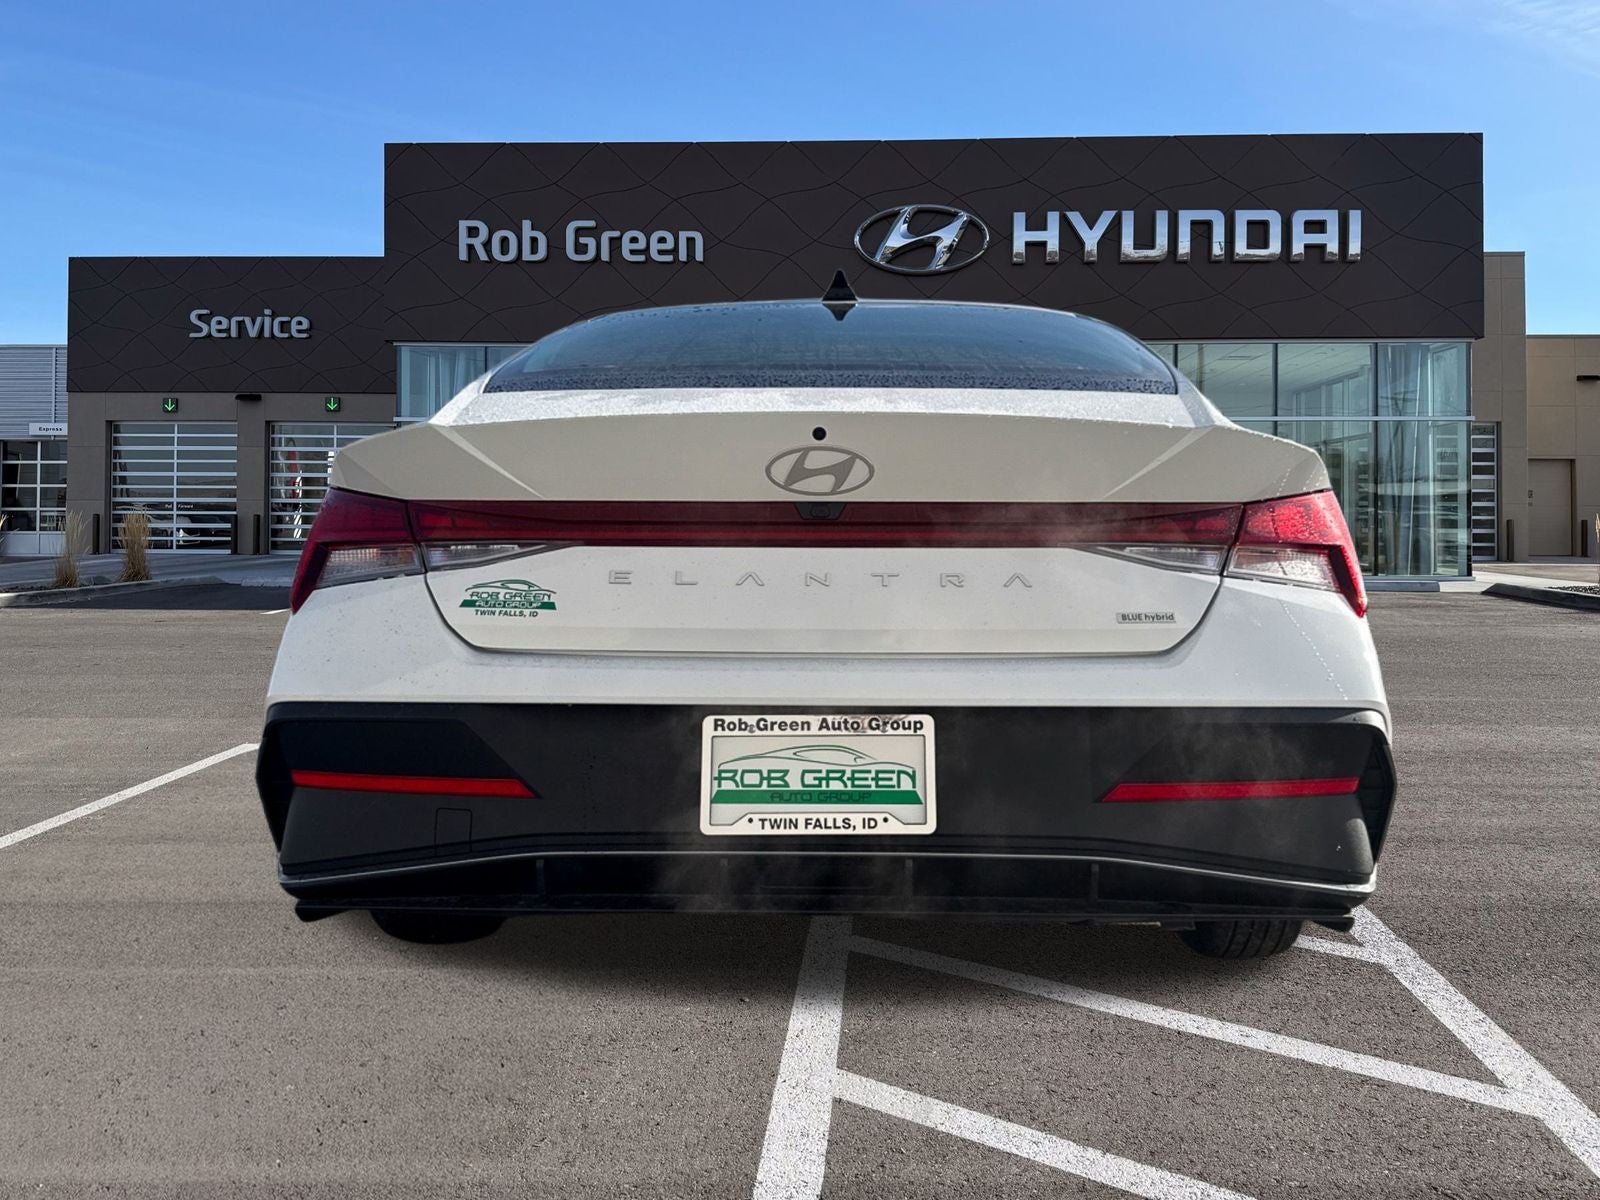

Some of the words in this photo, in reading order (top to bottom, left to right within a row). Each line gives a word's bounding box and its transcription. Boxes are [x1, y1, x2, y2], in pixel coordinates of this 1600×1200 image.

[458, 219, 548, 262] Rob
[565, 219, 704, 262] Green
[1012, 209, 1362, 264] HYUNDAI
[189, 309, 311, 338] Service
[608, 570, 1032, 588] ELANTRA
[470, 591, 500, 600] ROB
[504, 592, 551, 601] GREEN
[475, 600, 504, 608] AUTO
[498, 610, 526, 618] FALLS,
[1121, 613, 1142, 621] BLUE
[1144, 613, 1175, 622] hybrid
[713, 718, 748, 732] Rob
[756, 718, 811, 732] Green
[818, 717, 860, 732] Auto
[868, 717, 924, 733] Group
[714, 769, 791, 789] ROB
[800, 769, 917, 789] GREEN
[769, 792, 813, 802] AUTO
[817, 792, 872, 802] GROUP
[759, 818, 799, 830] TWIN
[804, 817, 856, 831] FALLS,
[862, 817, 878, 829] ID
